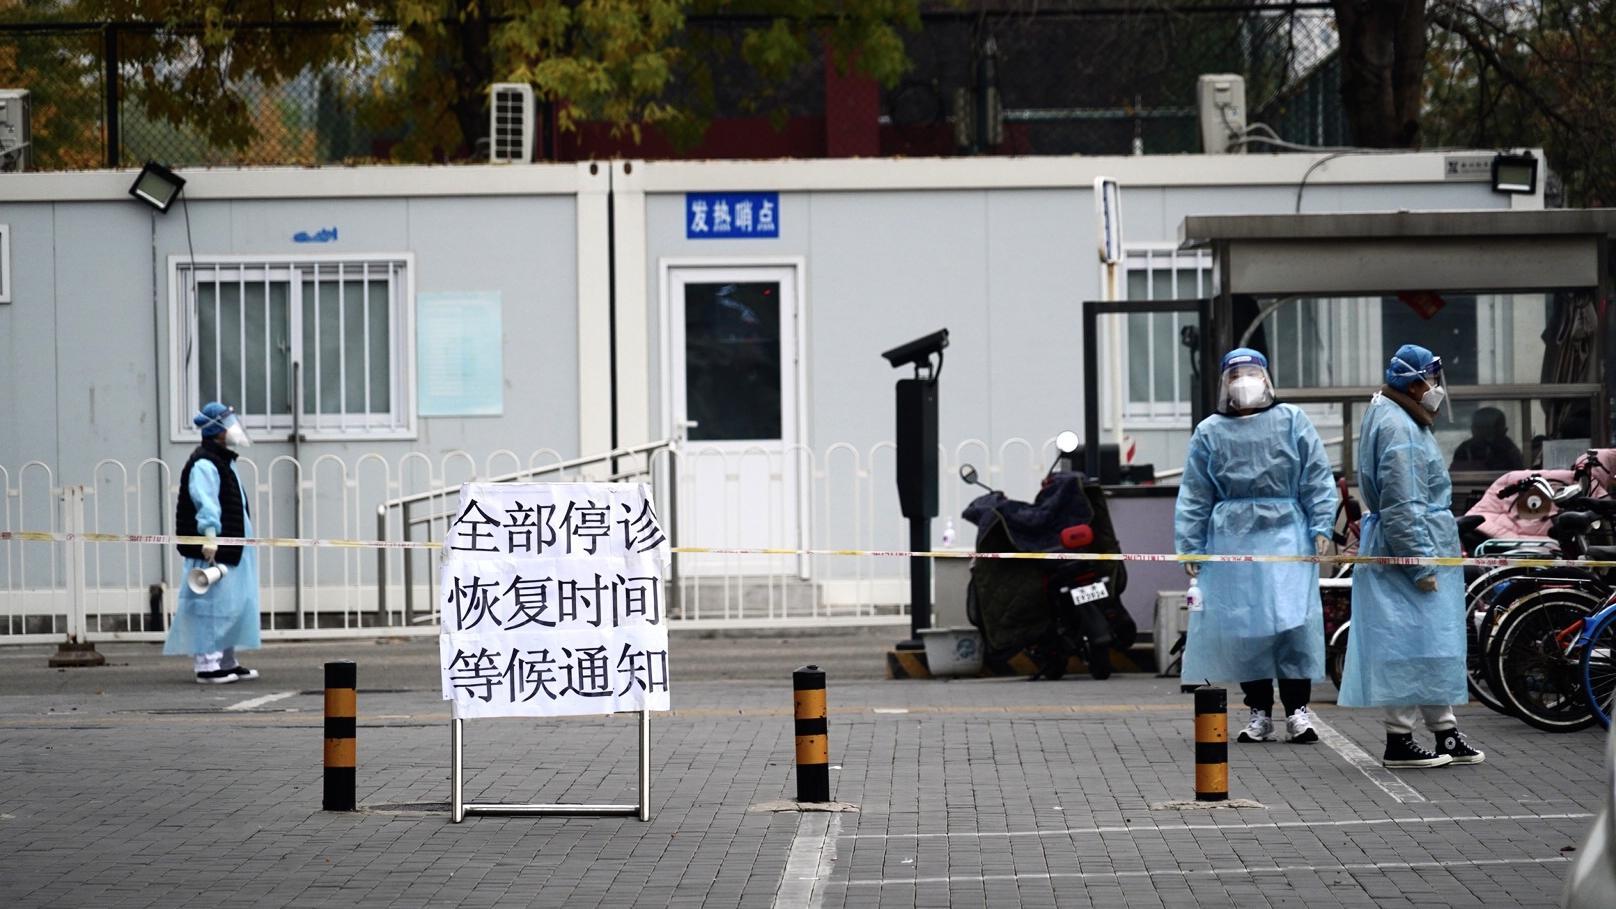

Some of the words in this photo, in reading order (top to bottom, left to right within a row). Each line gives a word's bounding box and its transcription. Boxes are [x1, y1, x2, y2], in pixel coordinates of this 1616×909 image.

[691, 200, 775, 232] 发热哨点
[451, 499, 666, 554] 全部停诊
[448, 573, 660, 630] 恢复时间
[448, 643, 668, 702] 等候通知
